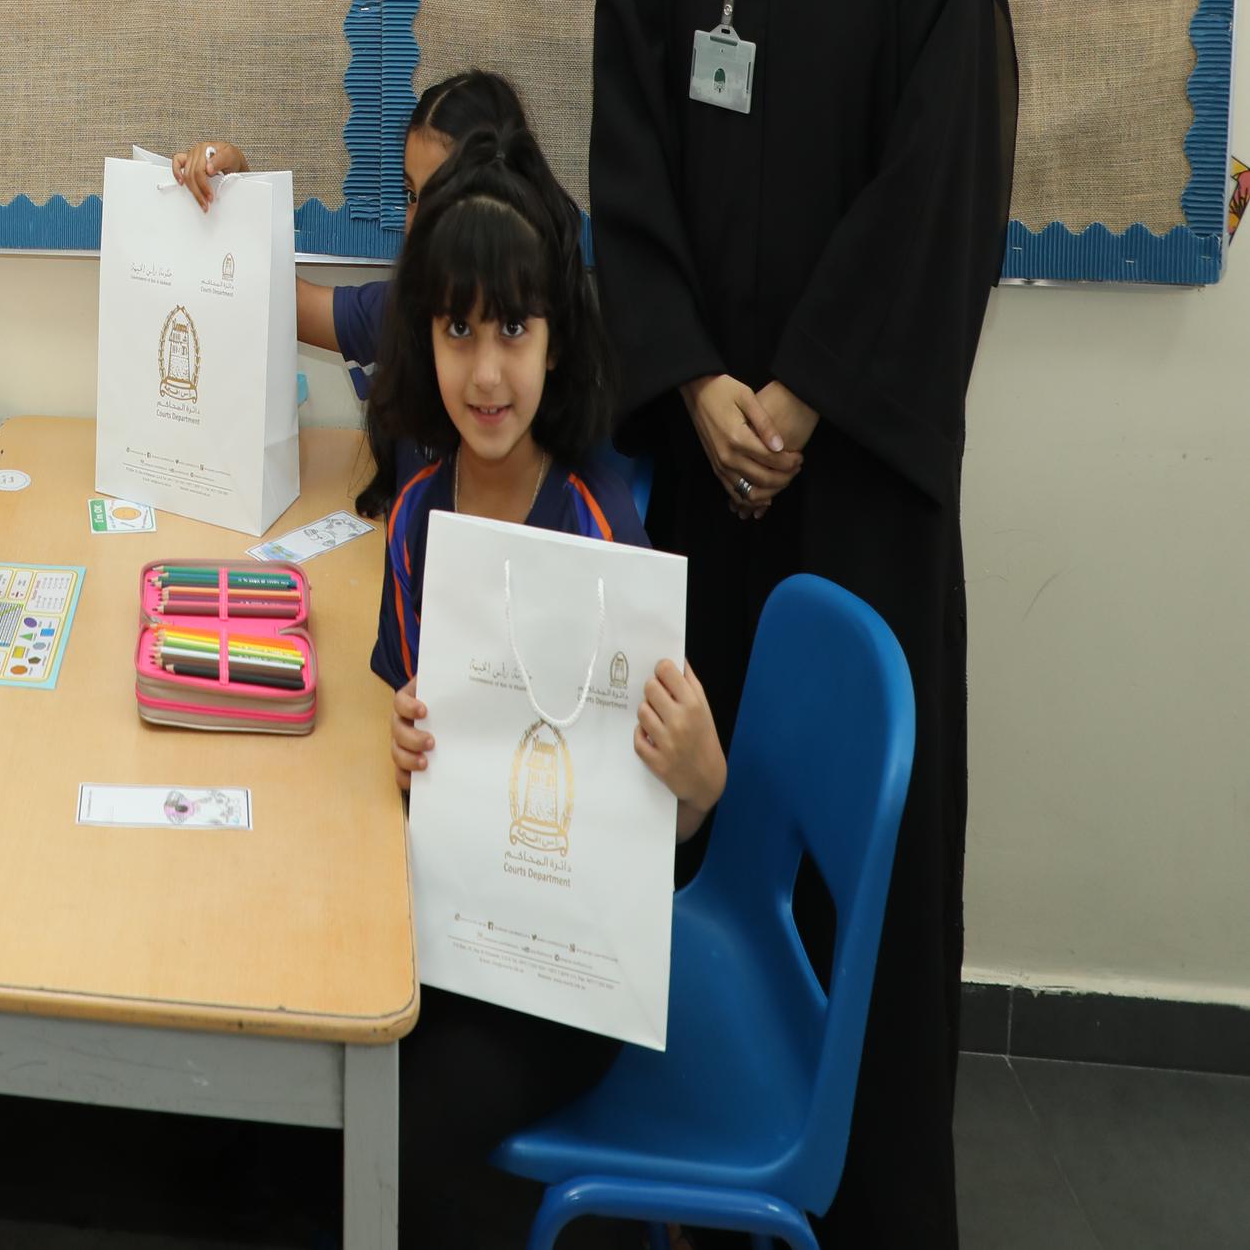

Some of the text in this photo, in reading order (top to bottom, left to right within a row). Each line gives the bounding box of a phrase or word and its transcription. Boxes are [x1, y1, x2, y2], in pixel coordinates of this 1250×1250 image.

[157, 409, 200, 424] Courts Department
[504, 862, 571, 887] Courts Department
